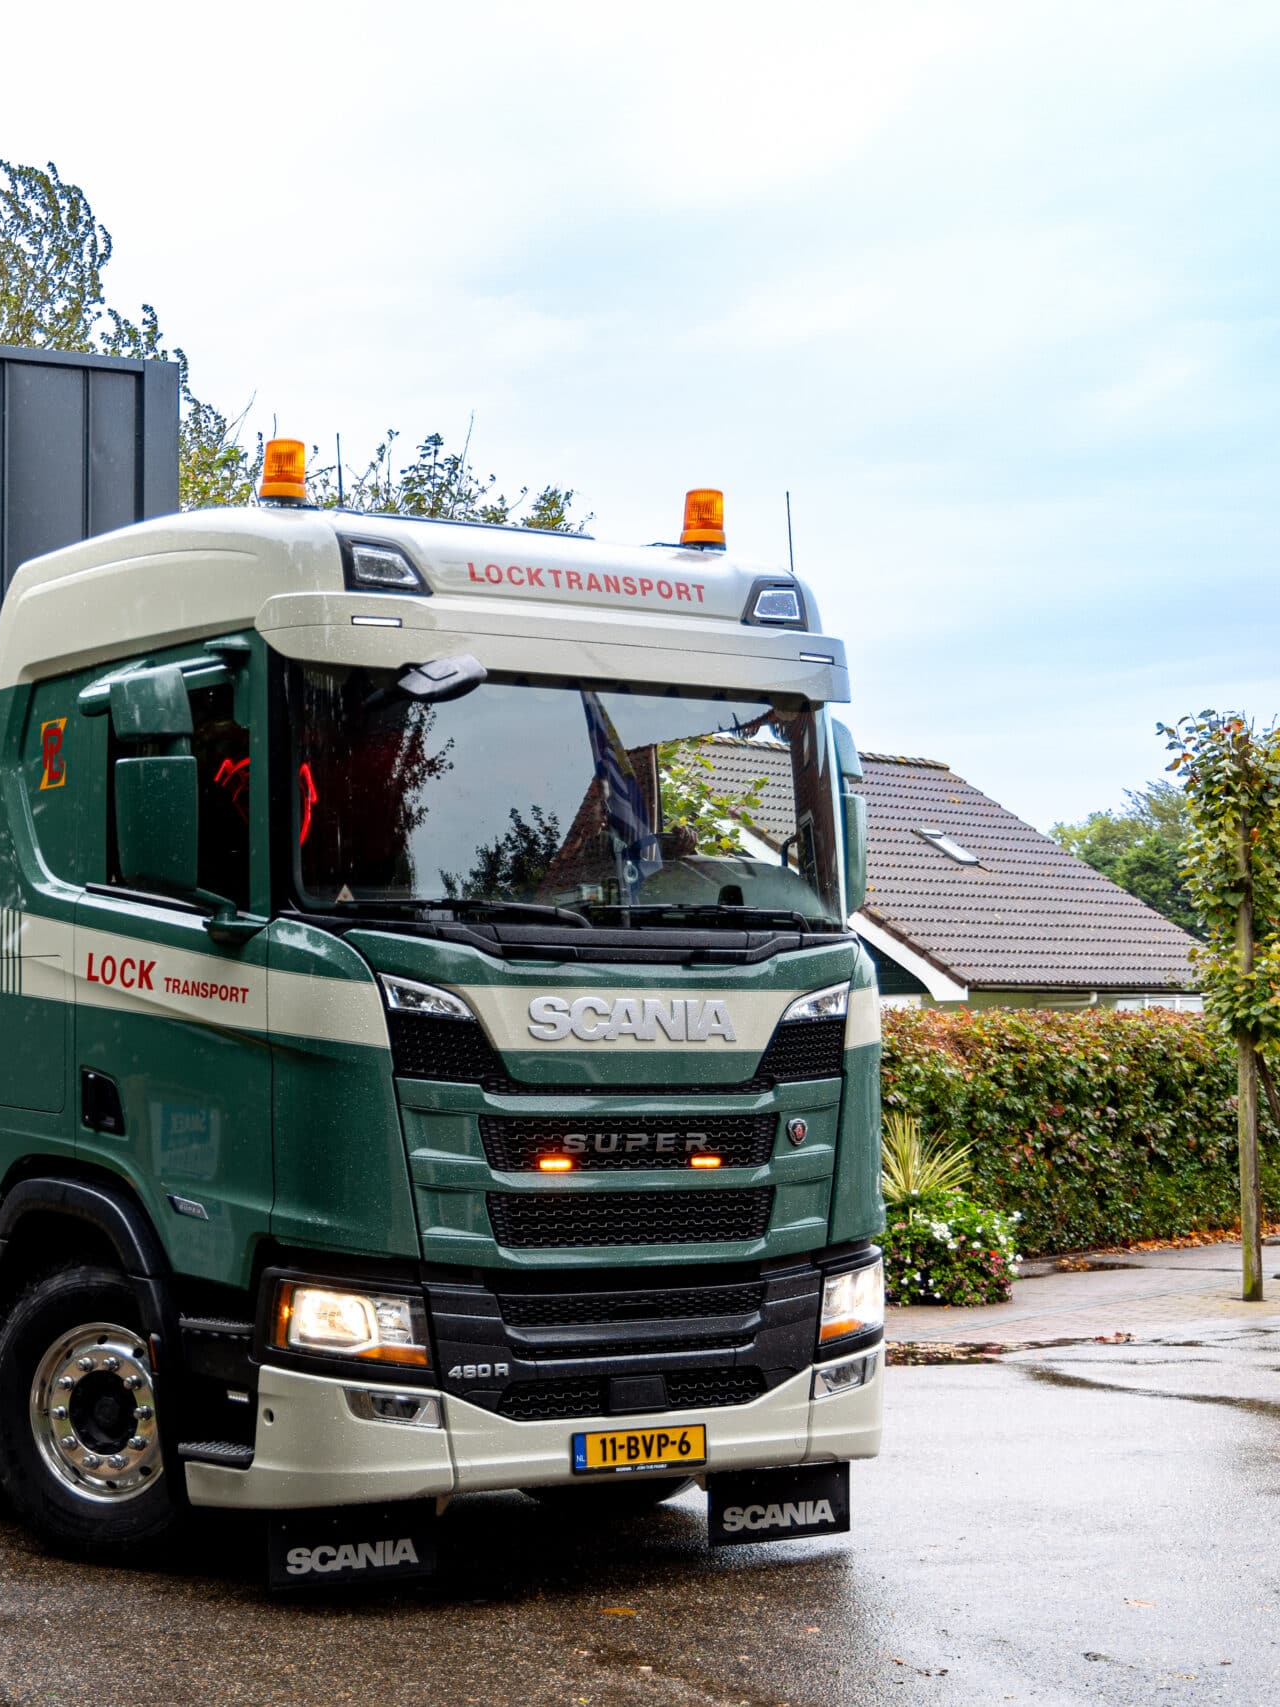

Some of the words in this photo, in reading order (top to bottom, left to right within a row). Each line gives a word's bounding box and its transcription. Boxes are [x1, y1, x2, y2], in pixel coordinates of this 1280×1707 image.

[86, 952, 156, 991] LOCK
[164, 977, 249, 1004] TRANSPORT
[528, 996, 737, 1042] SCANIA
[562, 1132, 709, 1154] SUPER
[448, 1364, 491, 1379] 460
[494, 1363, 509, 1377] R
[600, 1431, 691, 1462] 11-BVP-6
[723, 1499, 836, 1532] SCANIA
[286, 1538, 419, 1575] SCANIA
